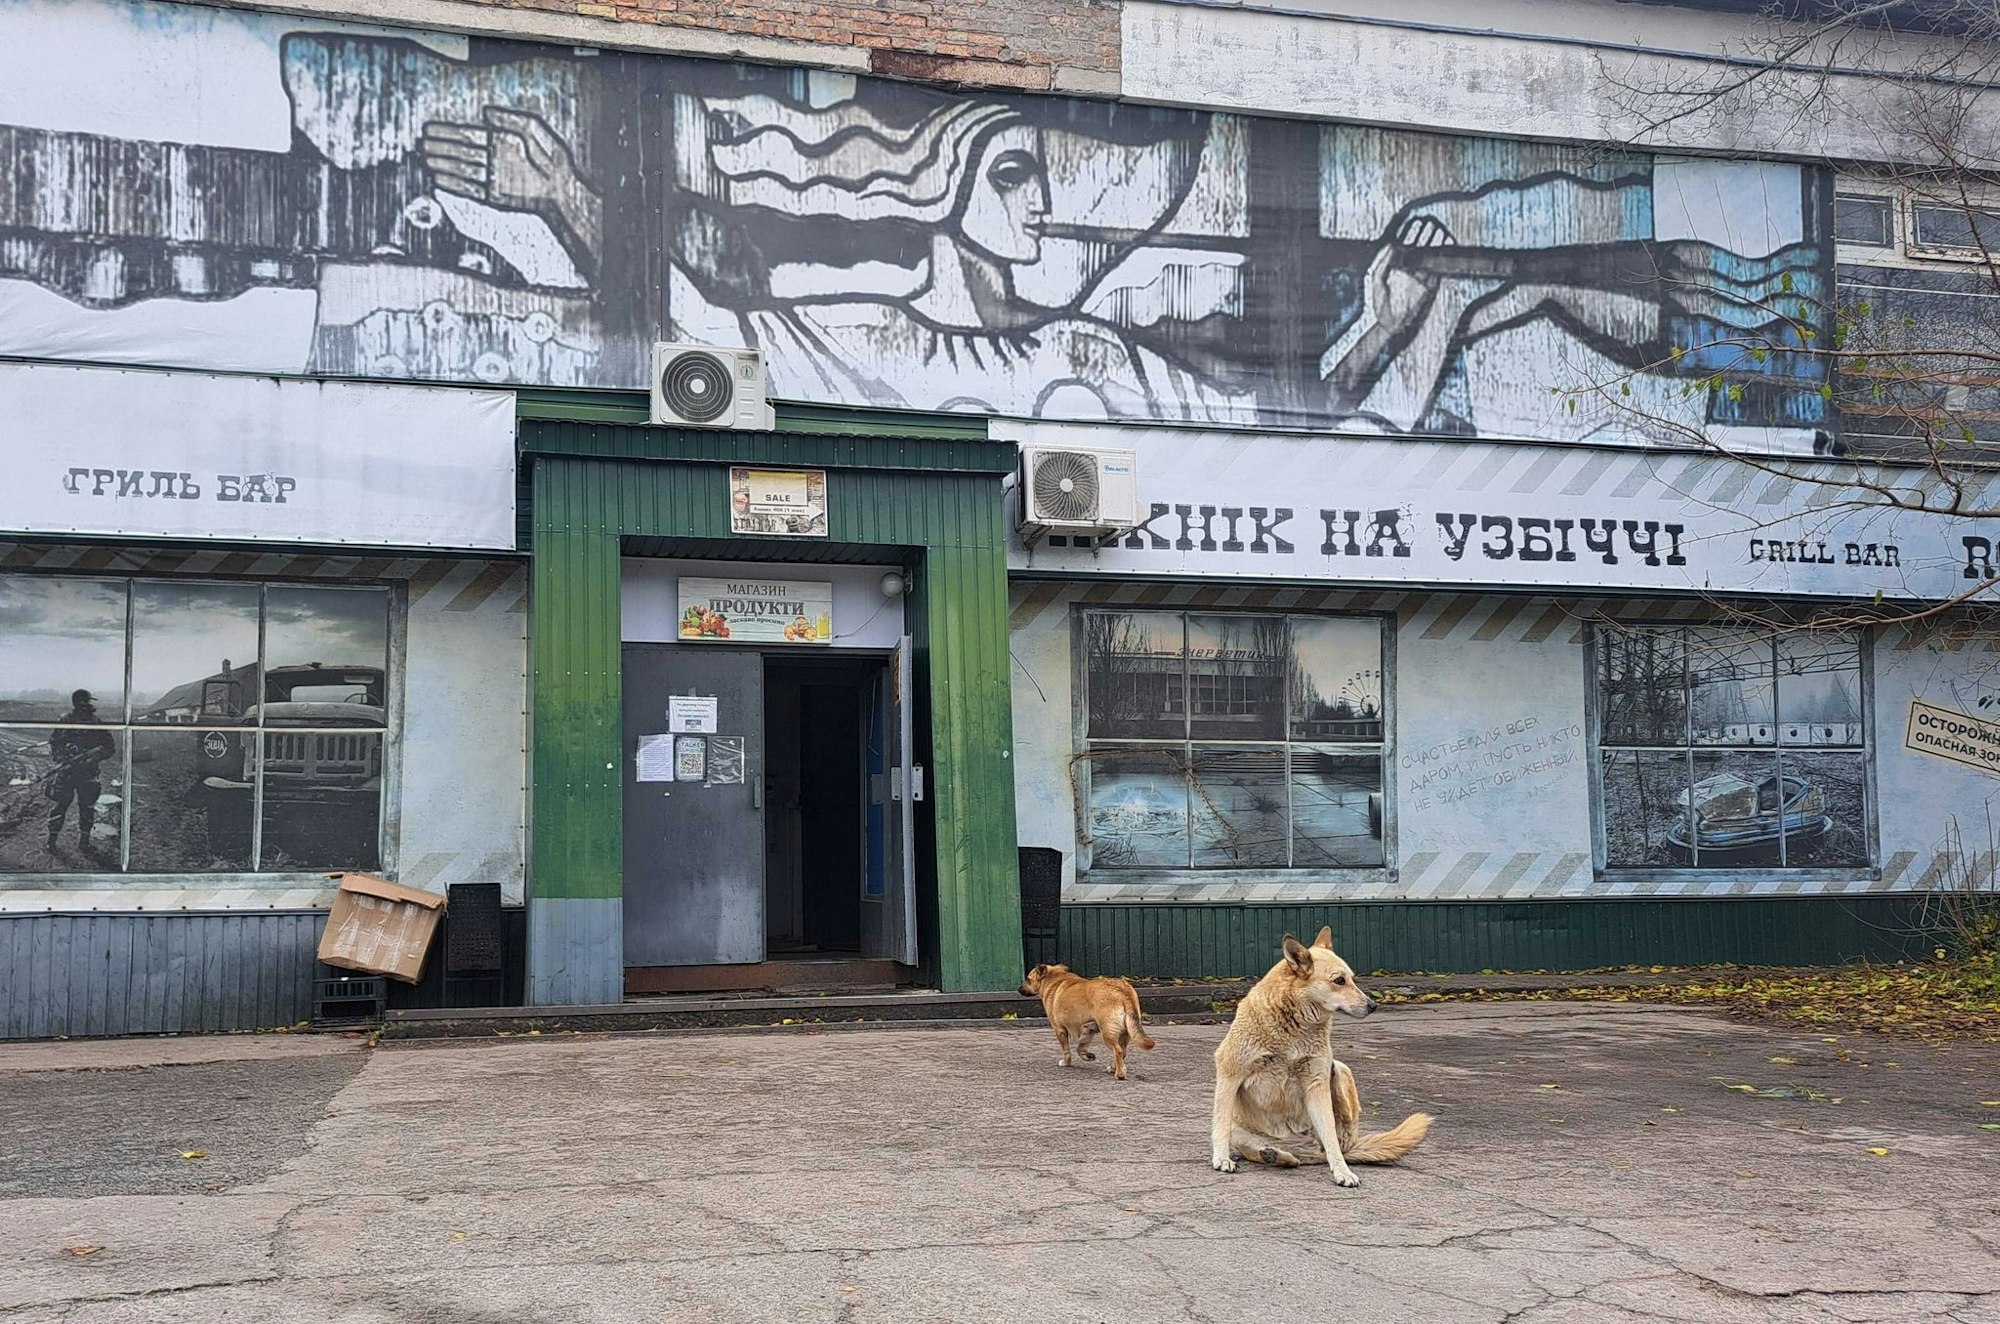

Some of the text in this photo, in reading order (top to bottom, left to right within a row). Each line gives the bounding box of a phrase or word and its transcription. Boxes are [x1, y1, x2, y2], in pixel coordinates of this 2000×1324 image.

[67, 468, 296, 504] ГРИЛЬ БАР
[765, 494, 791, 502] SALE
[1048, 503, 1688, 567] КНІК НА УЗБІЧЧІ
[1750, 539, 1901, 567] GRILL BAR
[1962, 536, 2000, 580] R
[726, 583, 786, 597] МАГАЗИН
[708, 599, 805, 617] ПРОДУКТИ
[1401, 715, 1541, 770] СЧАСТЬЕ ДЛЯ ВСЕХ
[1482, 743, 1532, 768] ПУСТЬ
[1536, 723, 1581, 750] НИКТО
[1915, 731, 1977, 757] ОПАСНАЯ
[1414, 797, 1432, 813] НЕ
